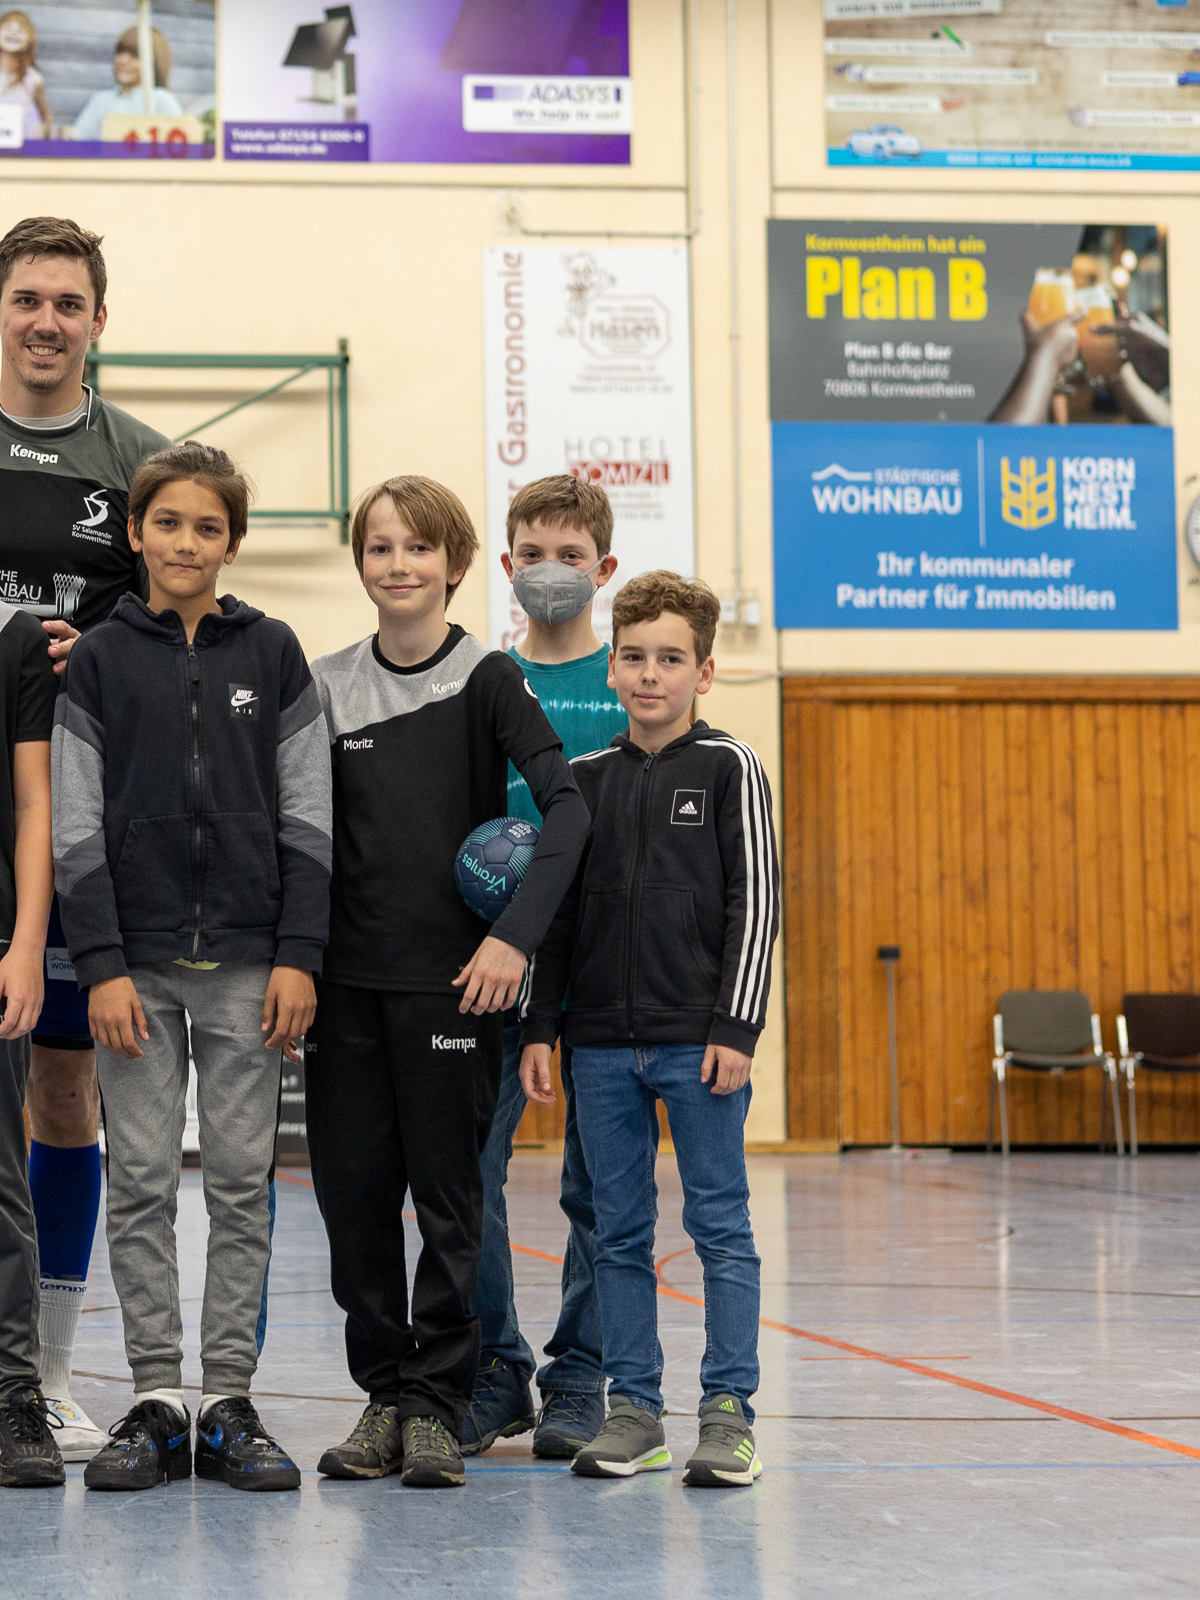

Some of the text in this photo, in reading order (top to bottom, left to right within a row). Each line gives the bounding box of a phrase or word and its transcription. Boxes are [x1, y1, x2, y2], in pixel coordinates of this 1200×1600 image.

[528, 85, 611, 104] ADASYS
[806, 234, 986, 254] Kornwestheim hat ein
[806, 256, 988, 321] Plan B
[498, 251, 528, 467] Gastronomie
[845, 342, 951, 360] Plan B die Bar
[847, 362, 950, 380] Bahnhofsplatz
[824, 380, 976, 398] 70806 Kornwestheim
[10, 444, 59, 464] Kempa
[564, 436, 669, 461] HOTEL
[874, 466, 960, 486] STÄDTISCHE
[1062, 457, 1135, 483] KORN
[812, 486, 962, 515] WOHNBAU
[1063, 483, 1134, 506] WEST
[1064, 506, 1136, 530] HEIM.
[71, 531, 112, 546] Kornwestheim
[72, 524, 113, 540] SV Salamander
[878, 552, 1074, 580] Ihr kommunaler
[837, 584, 1116, 612] Partner für Immobilien
[235, 689, 253, 700] NIKE
[431, 679, 463, 695] Kemp
[235, 707, 253, 715] AIR
[343, 737, 373, 750] Moritz
[462, 853, 506, 891] Vranjes
[432, 1034, 476, 1053] Kempa
